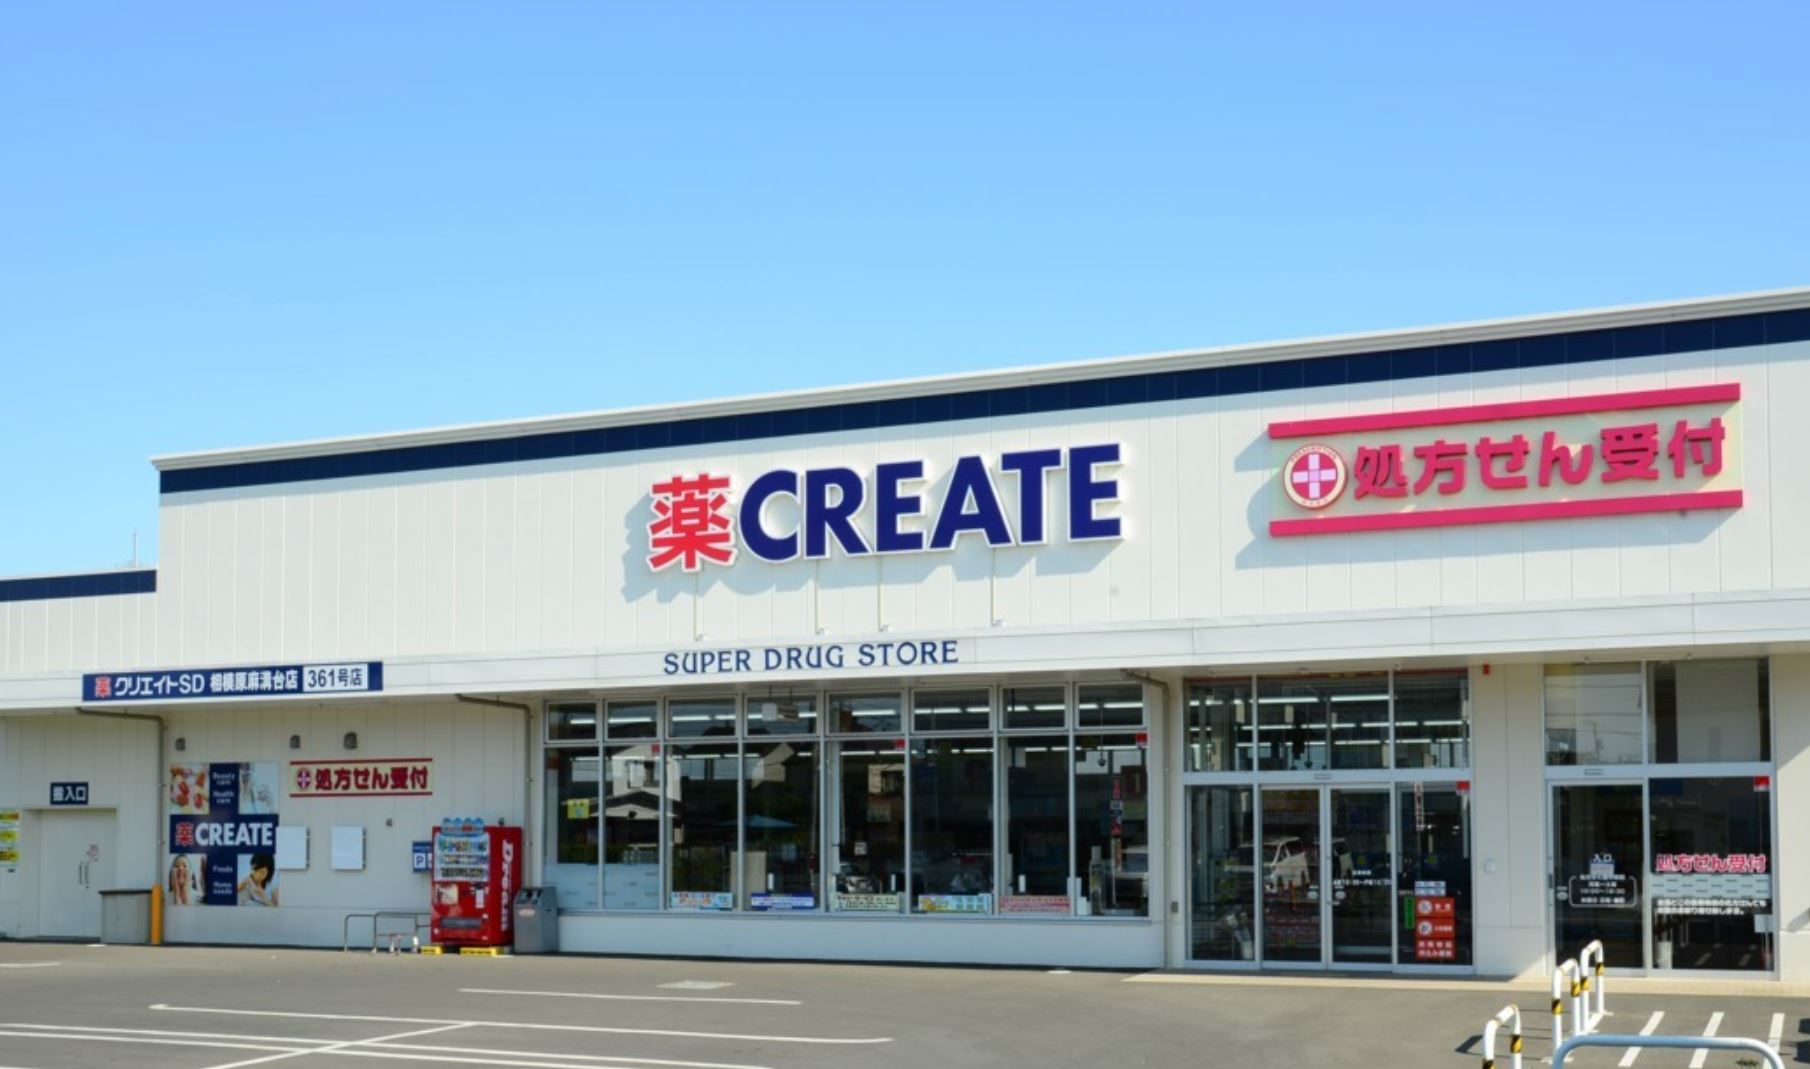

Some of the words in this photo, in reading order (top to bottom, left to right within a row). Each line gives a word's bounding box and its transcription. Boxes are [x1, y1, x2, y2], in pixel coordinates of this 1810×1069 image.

[1354, 417, 1726, 500] 処方せん受付
[649, 472, 735, 571] 薬
[739, 443, 1122, 561] CREATE
[663, 650, 752, 675] SUPER
[764, 645, 845, 672] DRUG
[858, 640, 960, 667] STORE
[114, 673, 206, 697] クリエイトSD
[306, 667, 363, 689] 361号店
[315, 765, 429, 791] 処方せん受付
[195, 822, 274, 847] CREATE
[1656, 853, 1767, 874] 処方せん受付
